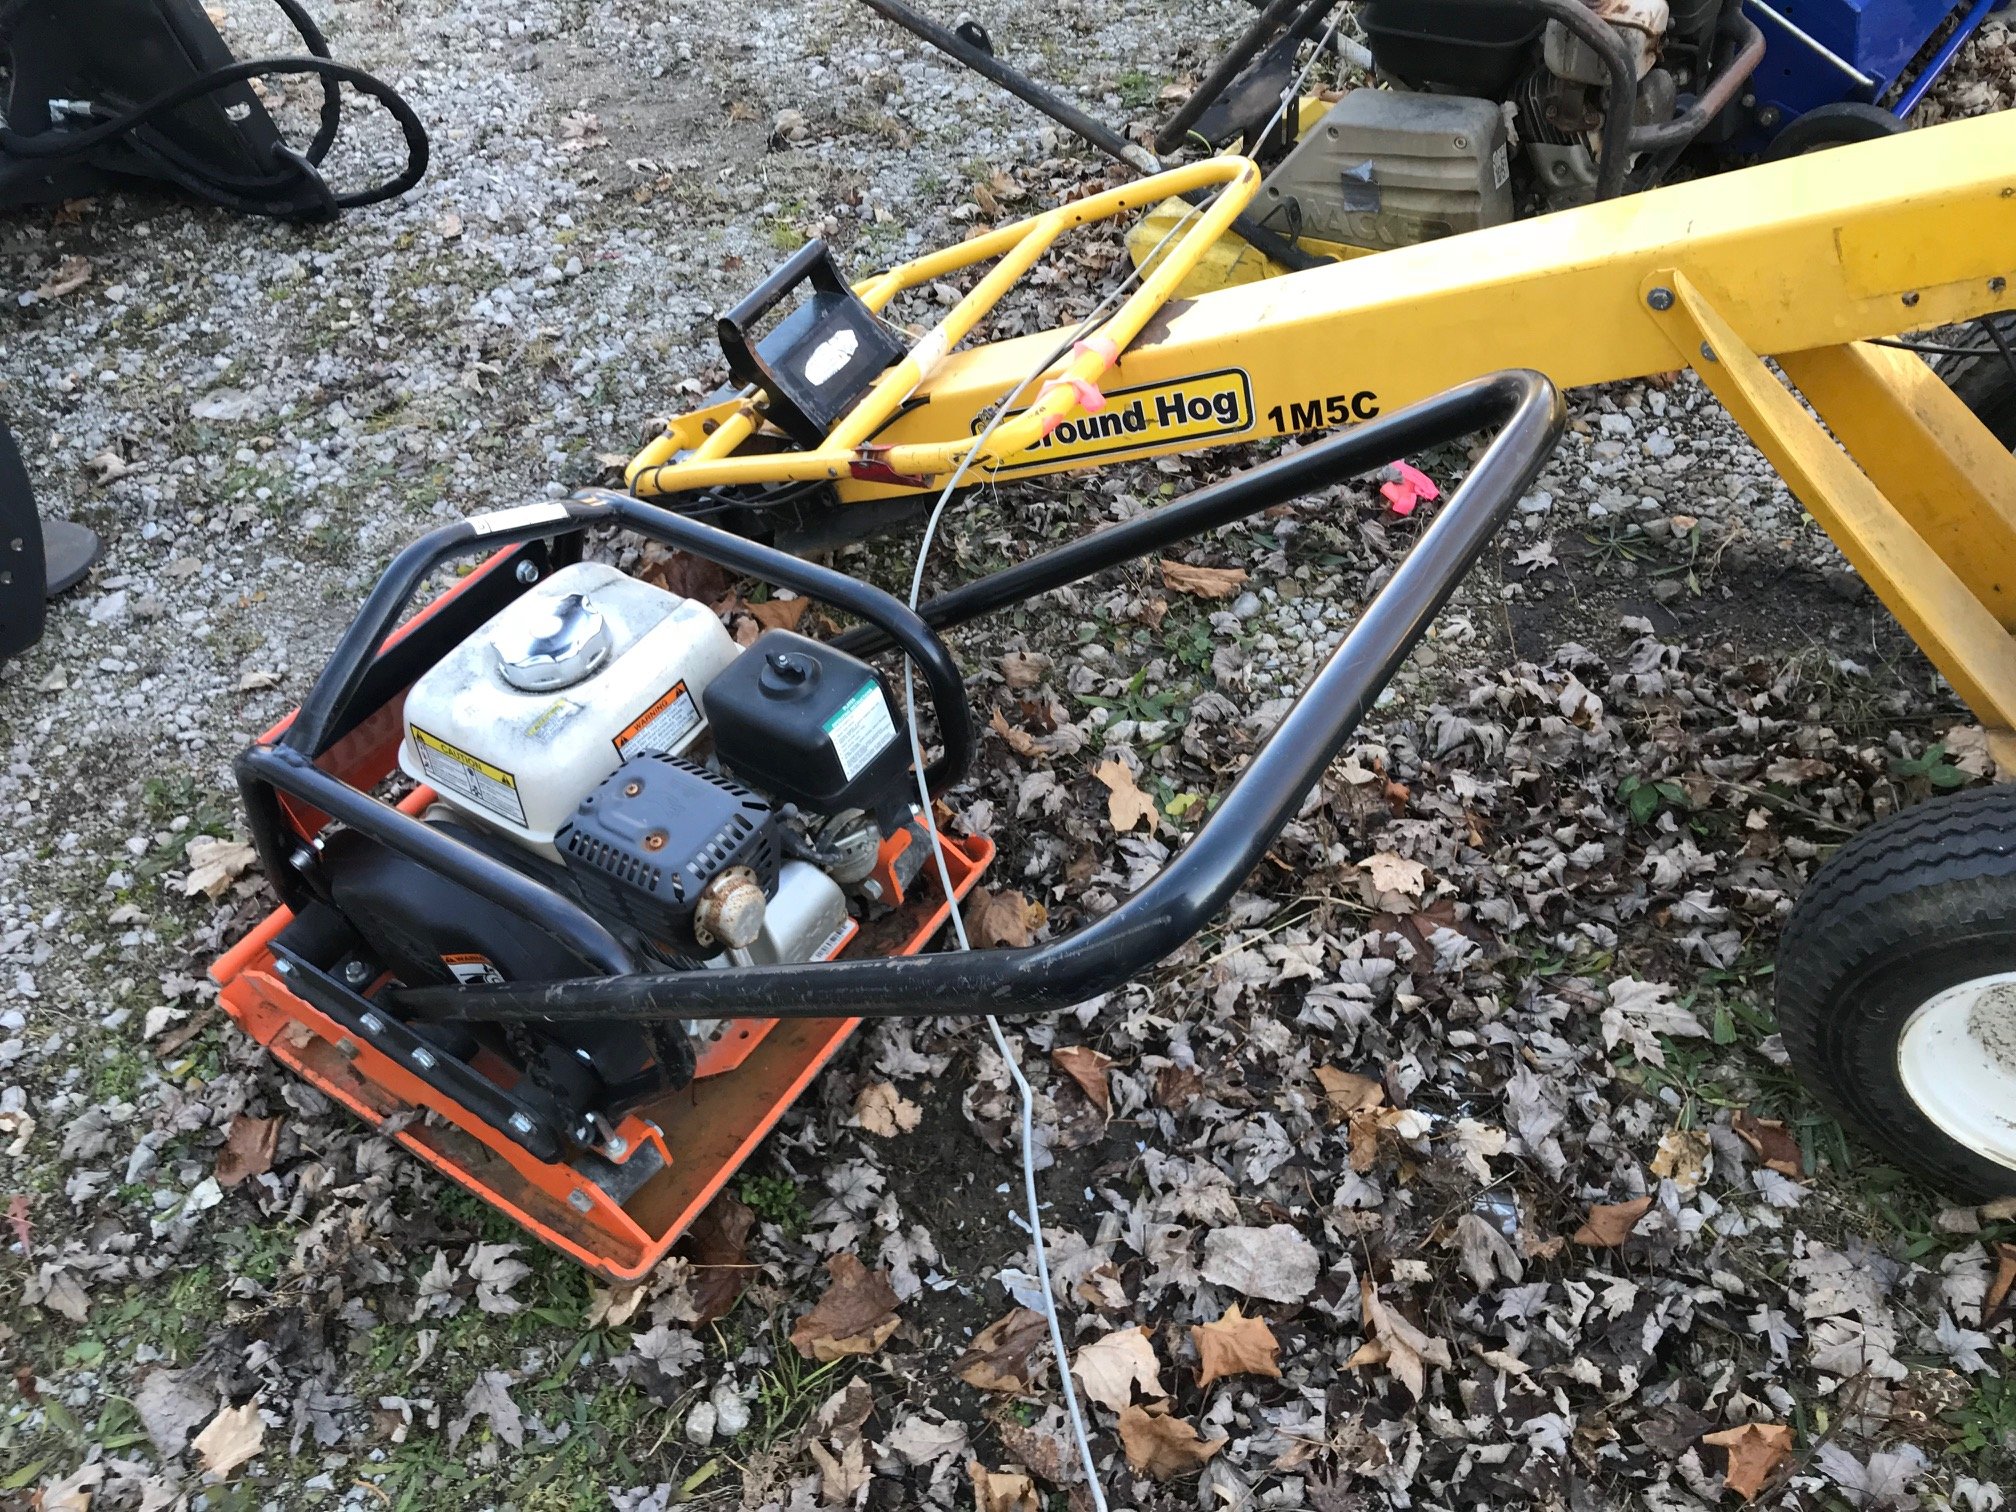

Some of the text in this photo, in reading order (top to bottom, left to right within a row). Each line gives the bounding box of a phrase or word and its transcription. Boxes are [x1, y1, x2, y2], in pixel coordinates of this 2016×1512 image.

[1025, 390, 1239, 450] round Hog
[1267, 390, 1380, 432] 1M5C
[633, 699, 668, 732] WARNING
[440, 744, 483, 771] CAUTION
